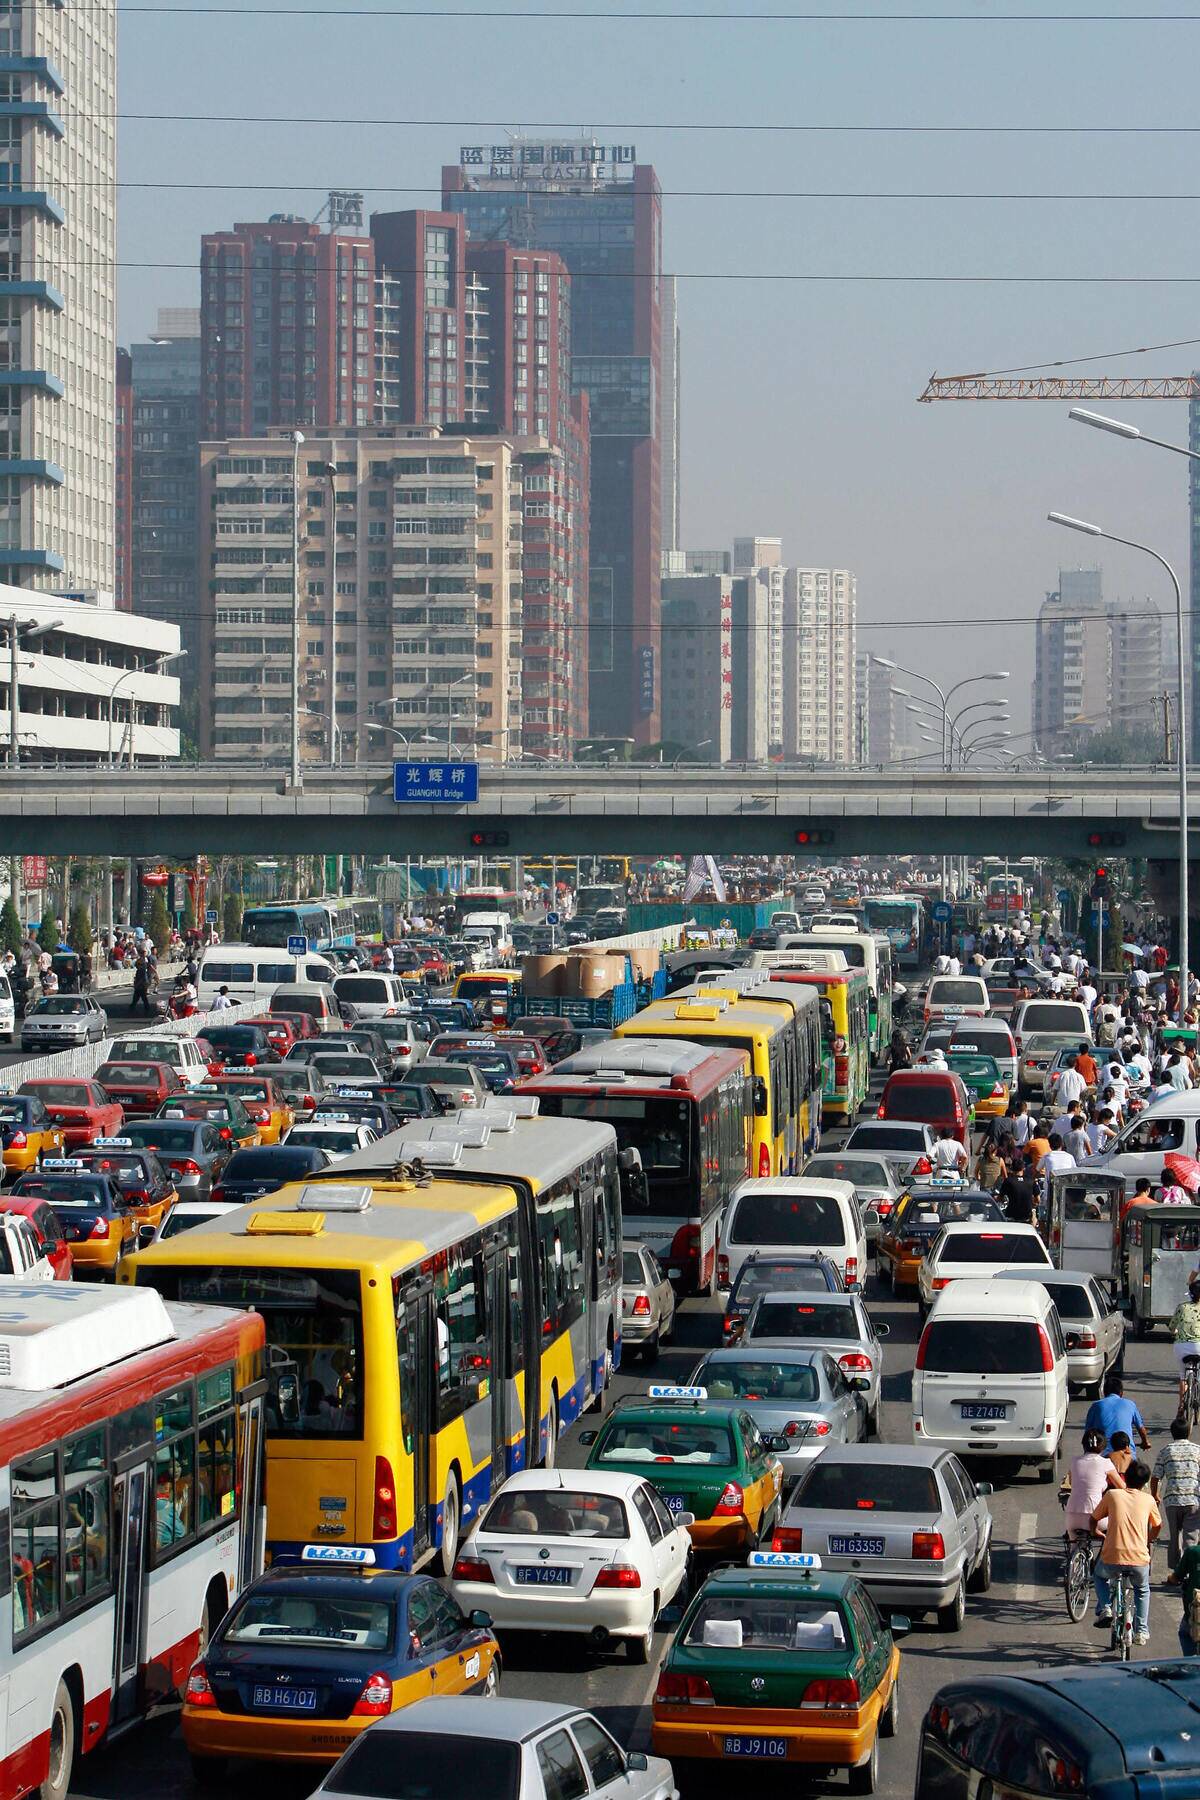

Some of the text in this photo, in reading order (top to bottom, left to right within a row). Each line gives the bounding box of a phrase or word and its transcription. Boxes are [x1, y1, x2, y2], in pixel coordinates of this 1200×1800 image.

[460, 146, 636, 164] 蓝堡国际中心
[490, 166, 606, 180] BLUE CASTLE
[406, 768, 465, 783] 光辉桥
[407, 789, 464, 799] GUANGHUI Bridge
[658, 1387, 698, 1396] TAXI
[976, 1407, 1005, 1418] Z7476
[312, 1547, 362, 1559] TAXI
[848, 1541, 882, 1553] G3355
[762, 1554, 811, 1565] TAXI
[535, 1570, 569, 1583] Y4941
[274, 1690, 314, 1705] H6707
[745, 1740, 785, 1755] J9106
